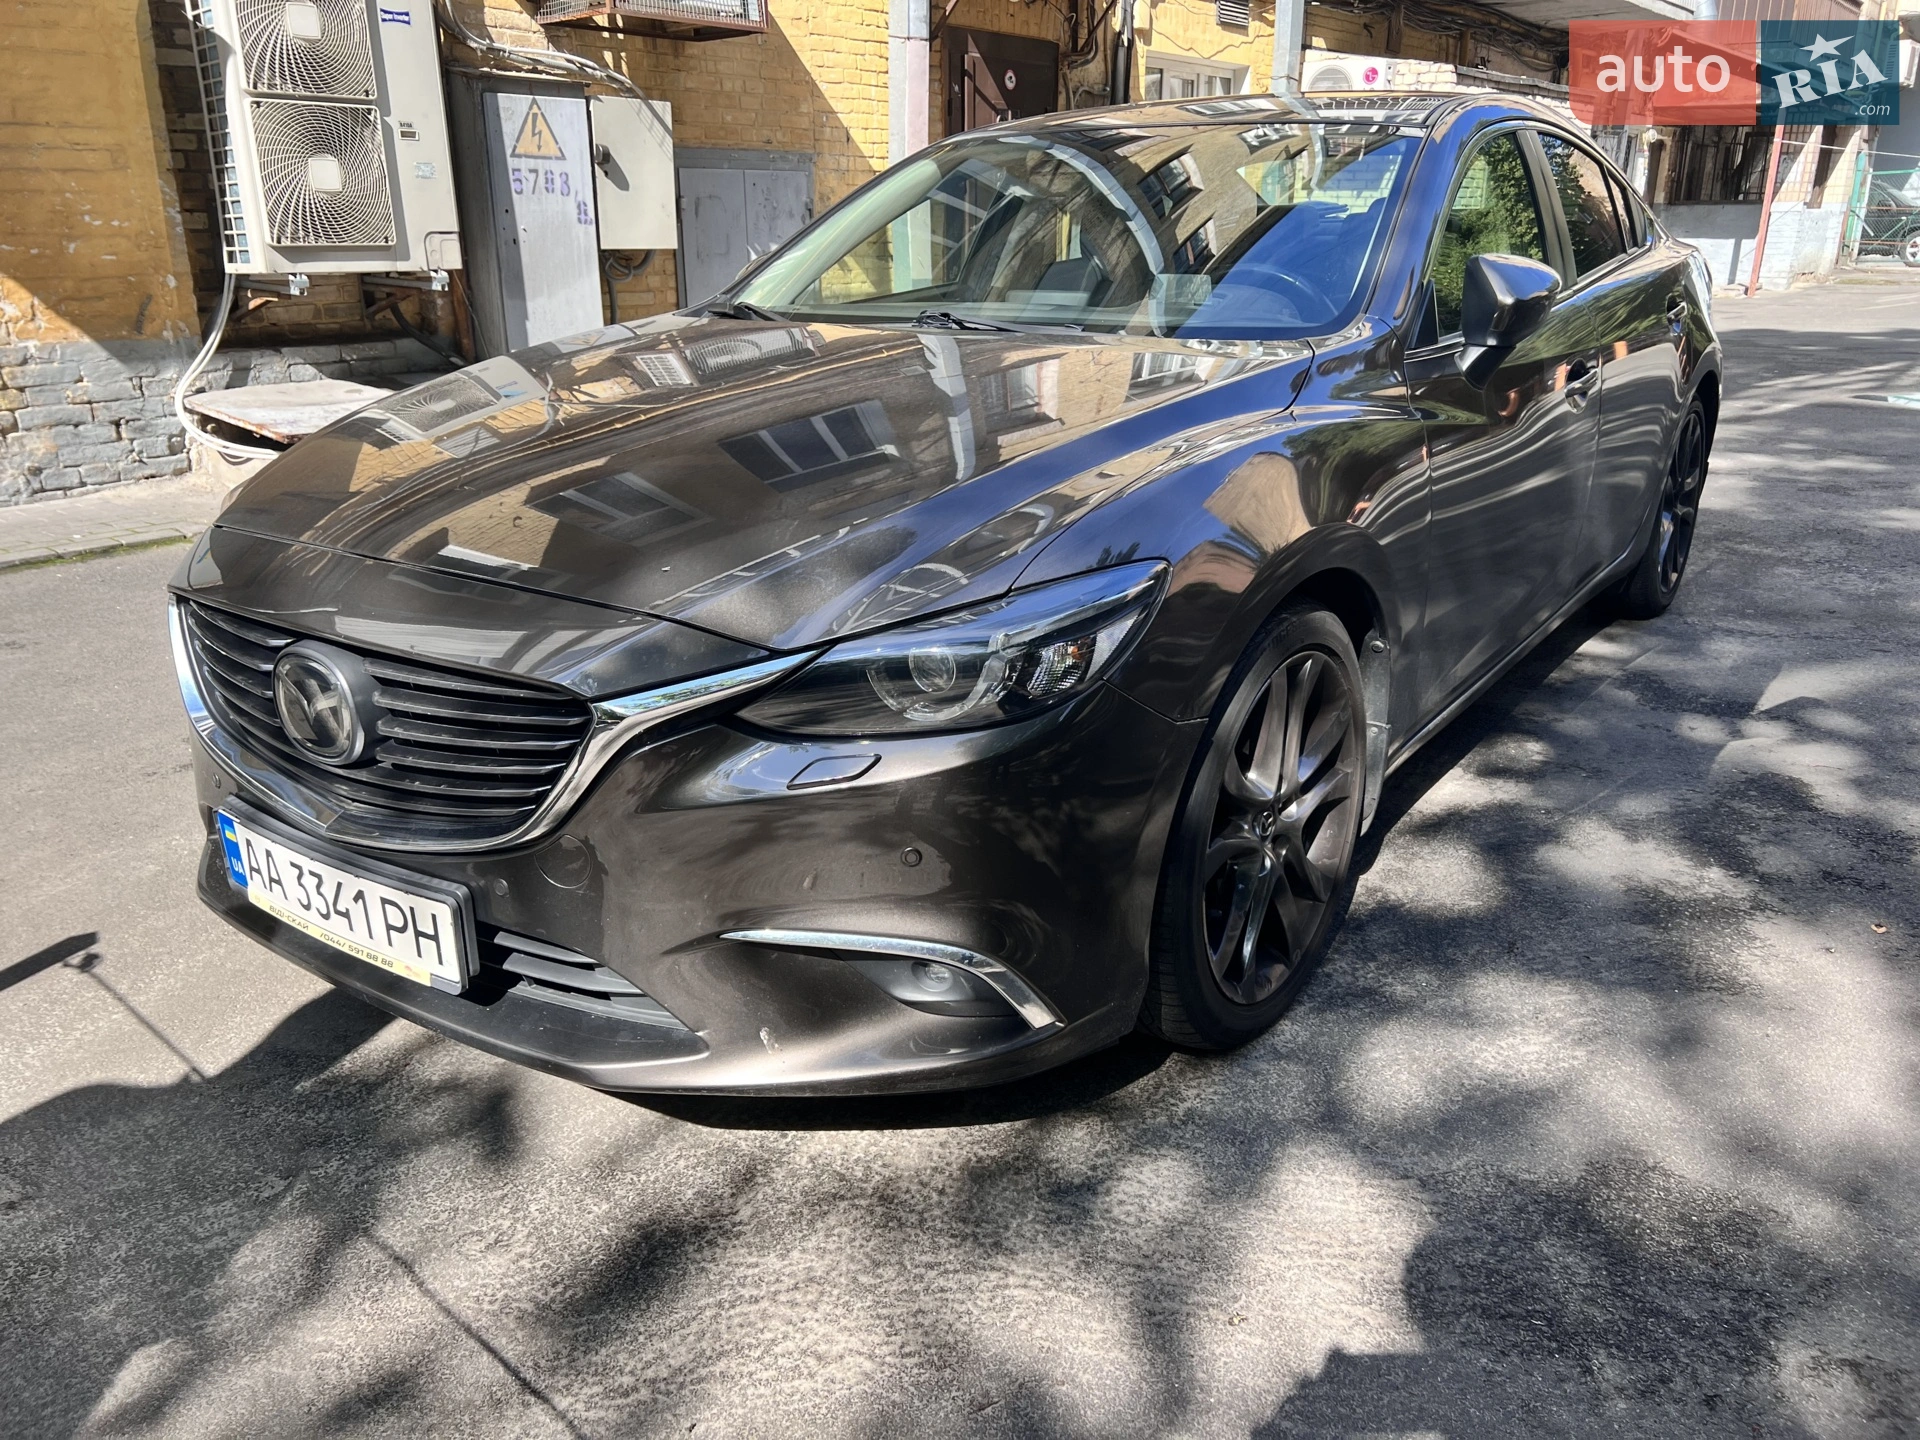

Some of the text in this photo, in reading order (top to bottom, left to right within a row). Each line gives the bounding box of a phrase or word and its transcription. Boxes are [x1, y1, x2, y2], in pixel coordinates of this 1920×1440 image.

[231, 857, 245, 876] UA
[245, 837, 444, 966] AA 3341 PH
[348, 944, 364, 957] 591
[366, 952, 379, 963] 88
[380, 957, 394, 968] 88
